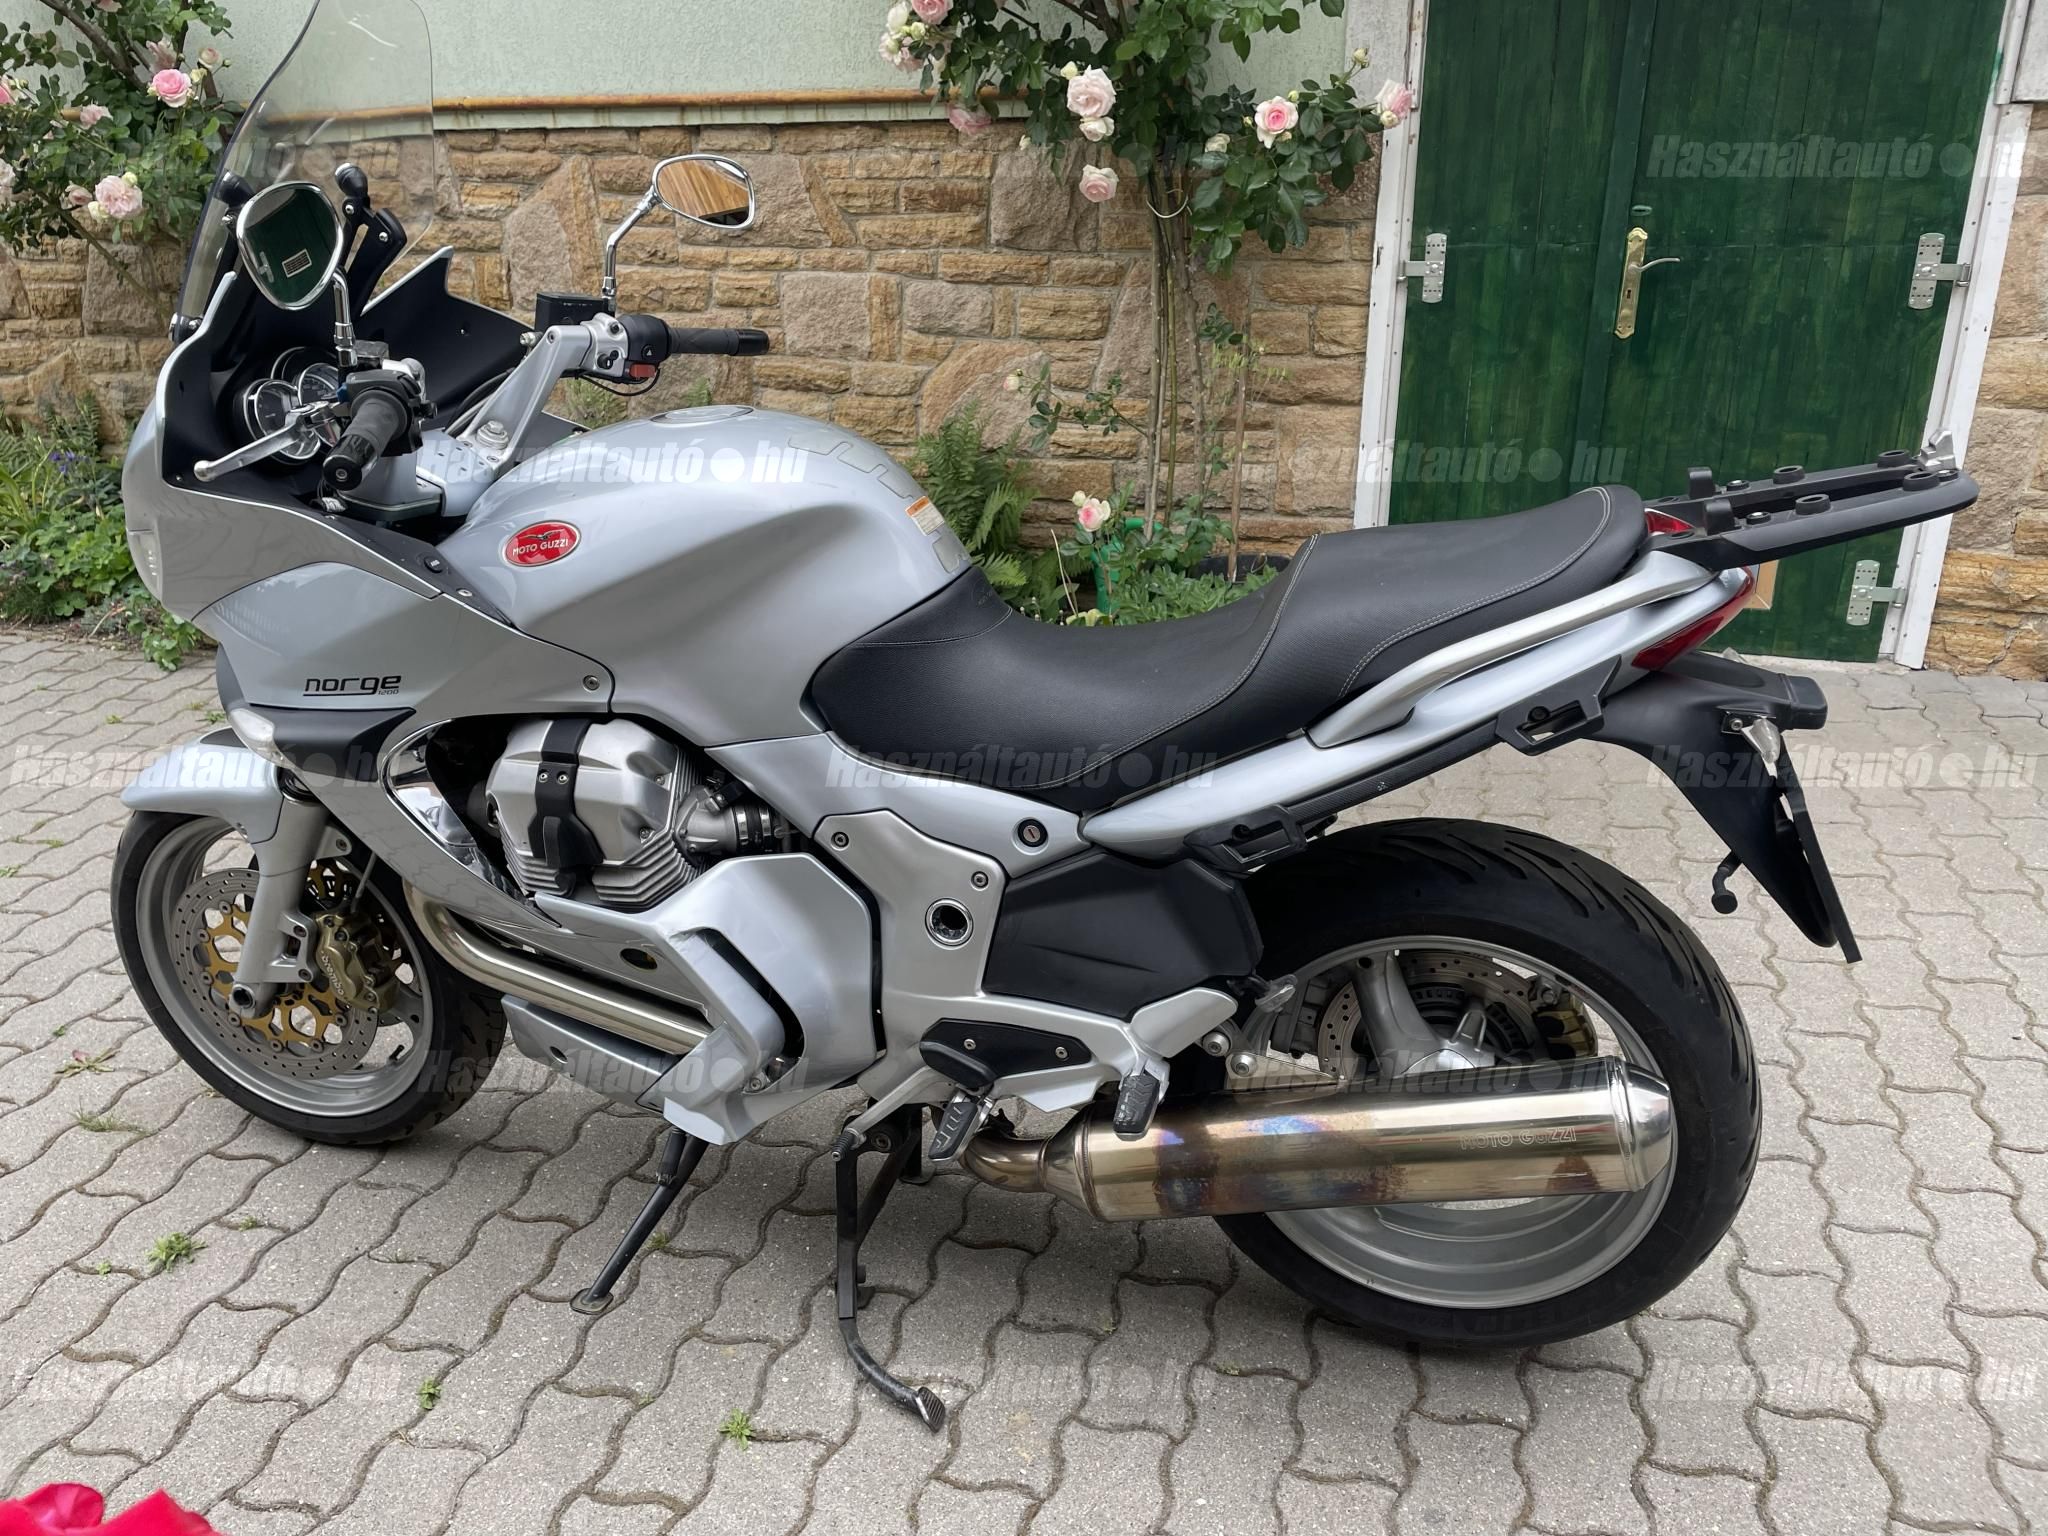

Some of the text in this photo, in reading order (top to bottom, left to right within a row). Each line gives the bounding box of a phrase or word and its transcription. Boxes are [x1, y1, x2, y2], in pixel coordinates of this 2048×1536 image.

[512, 538, 569, 557] MOTO GUZZI
[303, 675, 402, 697] norge
[1460, 1131, 1514, 1150] MOTO
